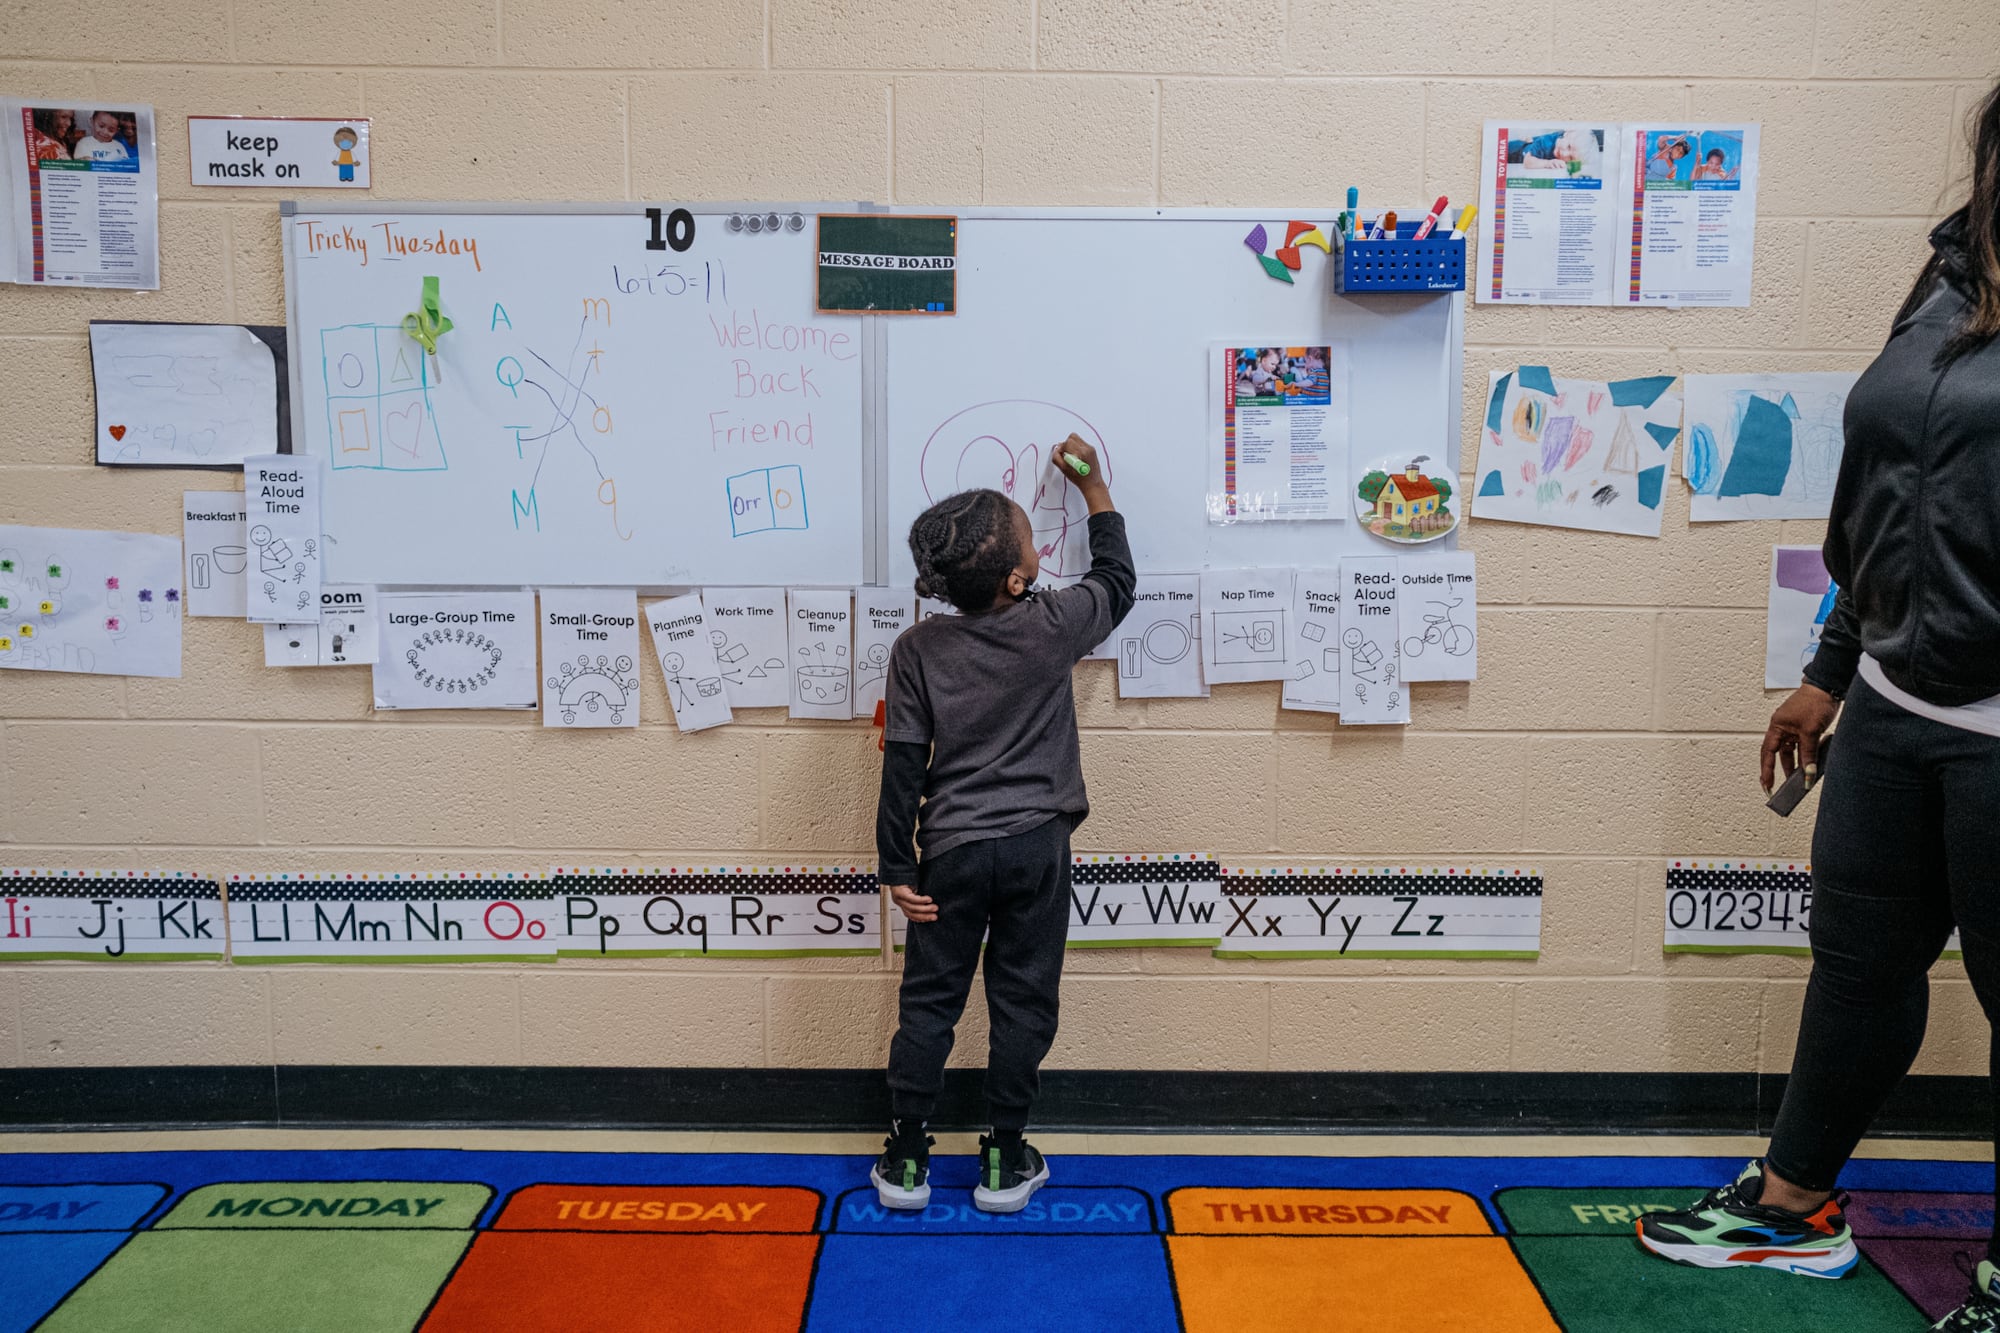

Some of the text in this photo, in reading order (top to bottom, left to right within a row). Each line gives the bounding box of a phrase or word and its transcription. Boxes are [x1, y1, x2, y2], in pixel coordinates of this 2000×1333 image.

[226, 129, 279, 157] keep
[209, 157, 300, 178] mask on
[645, 207, 696, 252] 10
[296, 221, 482, 272] Tricky Tuesday
[819, 252, 954, 270] MESSAGE BOARD
[491, 298, 611, 332] A m
[709, 308, 857, 361] Welcome
[496, 339, 605, 399] Q t
[731, 359, 821, 399] Back
[503, 405, 613, 459] T a
[709, 409, 814, 452] Friend
[260, 470, 304, 482] Read-
[260, 486, 304, 498] Aloud
[186, 511, 236, 521] Breakfast
[265, 501, 300, 513] Time
[512, 488, 540, 532] M
[1354, 572, 1396, 585] Read-
[1402, 573, 1473, 585] Outside Time
[1168, 591, 1194, 601] Time
[1221, 589, 1275, 601] Nap Time
[1305, 590, 1341, 603] Snack
[1354, 588, 1396, 600] Aloud
[388, 611, 516, 625] Large-Group Time
[714, 606, 774, 617] Work Time
[797, 608, 847, 623] Cleanup
[868, 607, 905, 618] Recall
[1308, 603, 1336, 614] Time
[1358, 603, 1392, 616] Time
[549, 613, 635, 628] Small-Group
[653, 613, 703, 633] Planning
[808, 621, 836, 633] Time
[872, 619, 900, 630] Time
[576, 629, 608, 641] Time
[667, 627, 695, 642] Time
[1071, 884, 1216, 926] Vv Ww
[5, 898, 213, 957] Ii Jj Kk
[251, 901, 546, 942] Ll Mm Nn Oo
[566, 896, 866, 954] Pp Qq Rr Ss
[1225, 896, 1445, 955] Xx Yy Zz
[205, 1197, 449, 1218] MONDAY
[556, 1200, 768, 1222] TUESDAY
[847, 1203, 1145, 1223] WDNSDAY
[1204, 1203, 1452, 1225] THURSDAY
[1570, 1204, 1677, 1224] FRI
